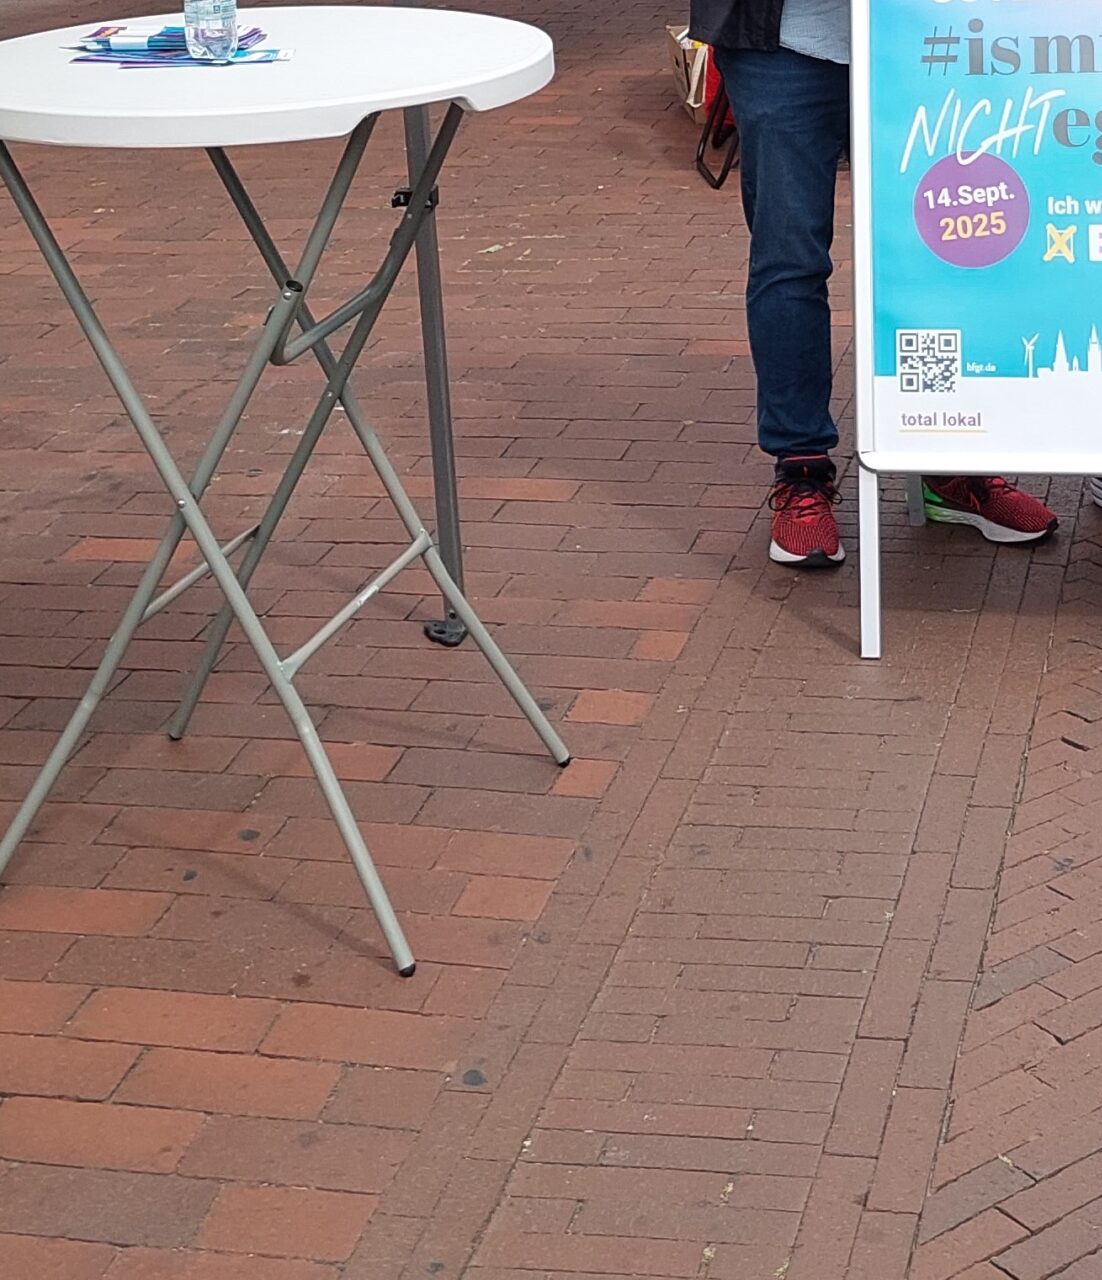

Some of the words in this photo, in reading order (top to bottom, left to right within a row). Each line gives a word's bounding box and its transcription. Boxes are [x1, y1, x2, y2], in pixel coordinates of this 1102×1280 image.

[900, 86, 1066, 174] NICHT
[1047, 194, 1079, 215] Ich
[939, 211, 1007, 240] 2025
[966, 361, 997, 374] bfgt.de
[901, 411, 938, 428] total
[942, 411, 982, 428] lokal
